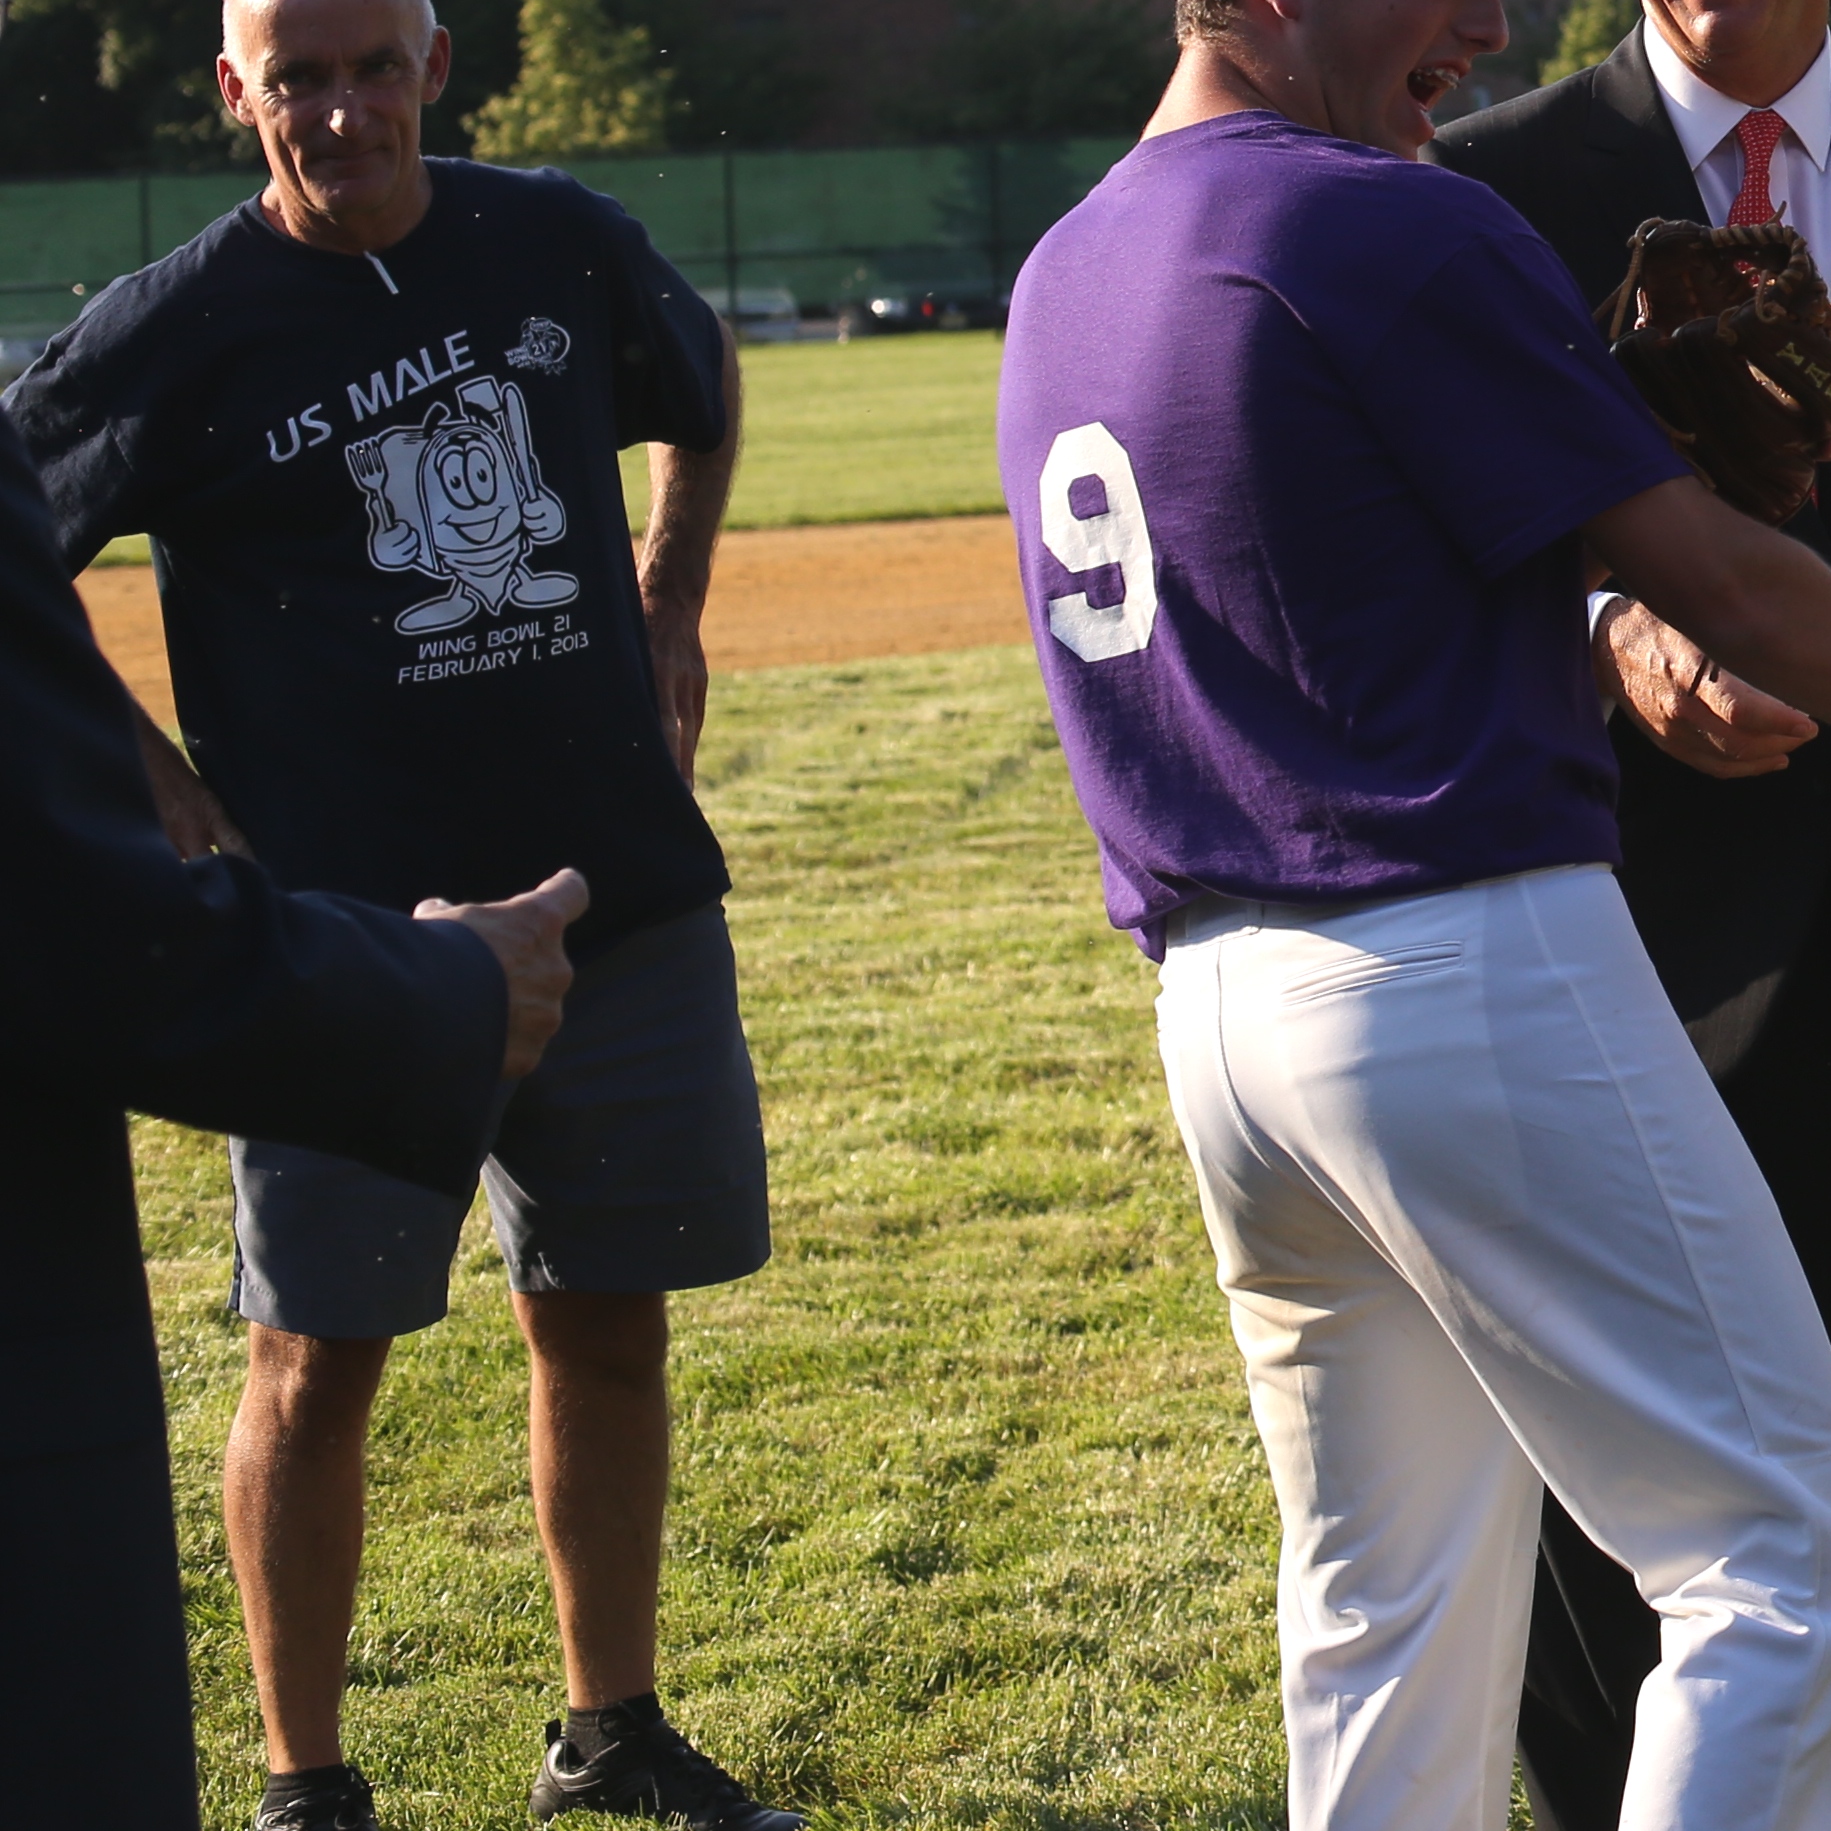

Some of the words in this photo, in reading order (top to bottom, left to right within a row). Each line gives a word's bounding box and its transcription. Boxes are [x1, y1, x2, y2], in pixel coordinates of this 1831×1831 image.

[266, 402, 333, 463] US
[346, 329, 476, 423] MALE
[1039, 420, 1158, 663] 9
[397, 647, 523, 684] FEBRUARY
[550, 631, 590, 656] 2013
[418, 635, 477, 661] WING
[487, 621, 545, 649] BOWL
[553, 614, 571, 633] 21
